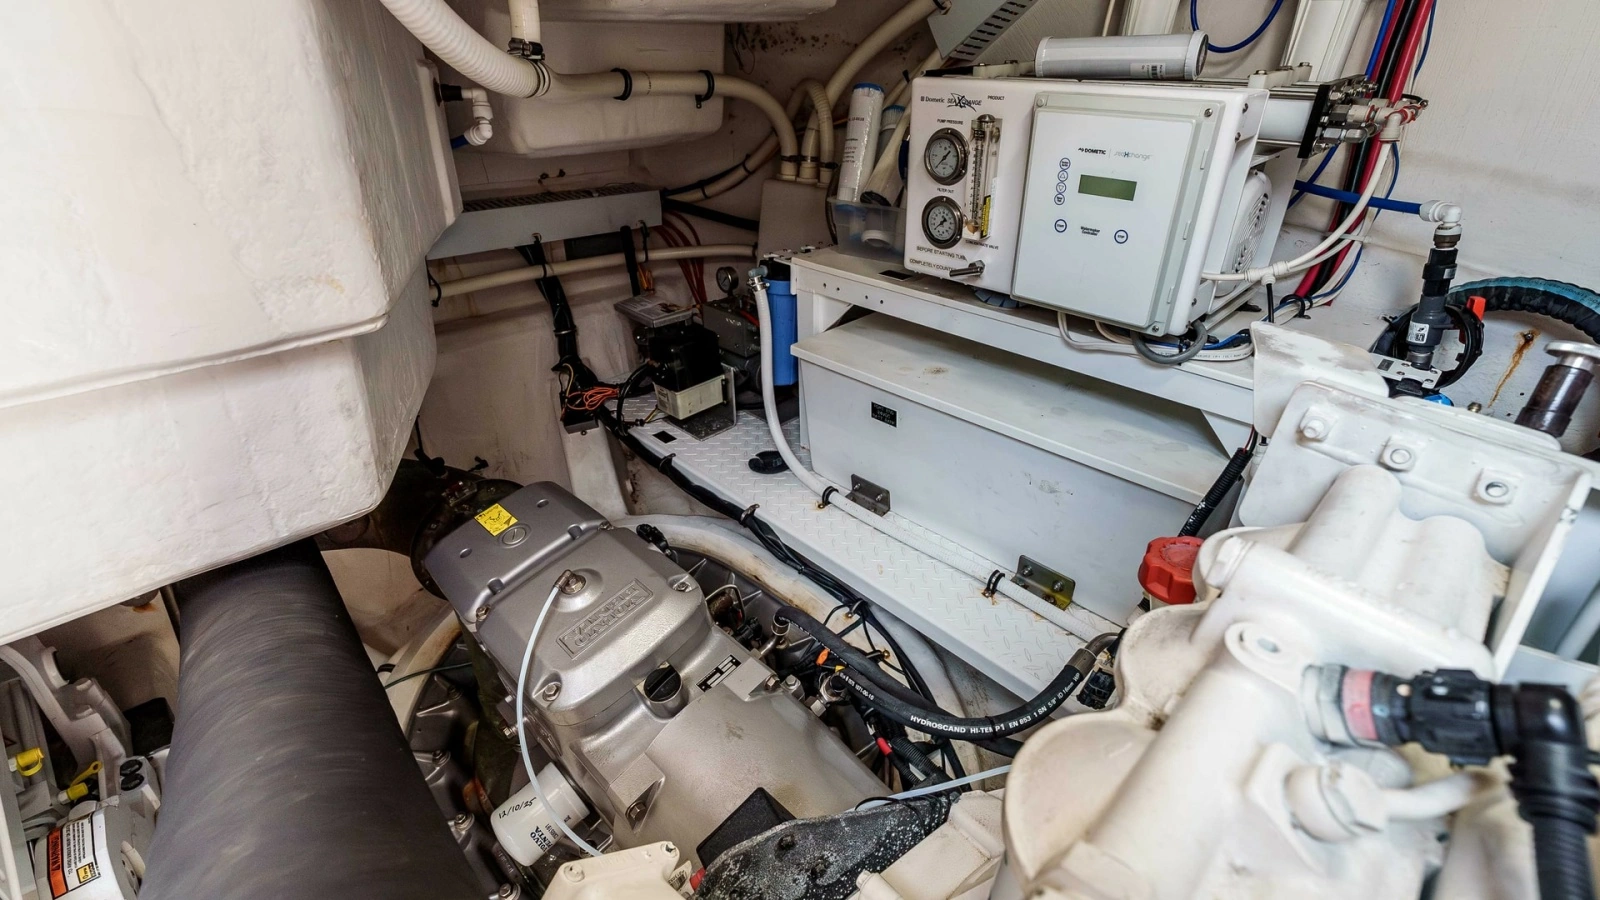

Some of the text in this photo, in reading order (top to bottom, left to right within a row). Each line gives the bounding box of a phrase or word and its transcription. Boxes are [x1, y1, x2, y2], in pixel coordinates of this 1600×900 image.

[916, 246, 933, 254] BEFORE
[934, 249, 955, 258] STARTING
[910, 259, 936, 268] COMPLETELY
[910, 715, 966, 734] HYDROSCAND
[1009, 720, 1018, 729] EN
[1019, 715, 1032, 725] 853
[1038, 706, 1047, 716] SN
[498, 797, 536, 819] 12/10/25
[530, 832, 548, 852] VOLVO
[535, 826, 553, 848] PENTA
